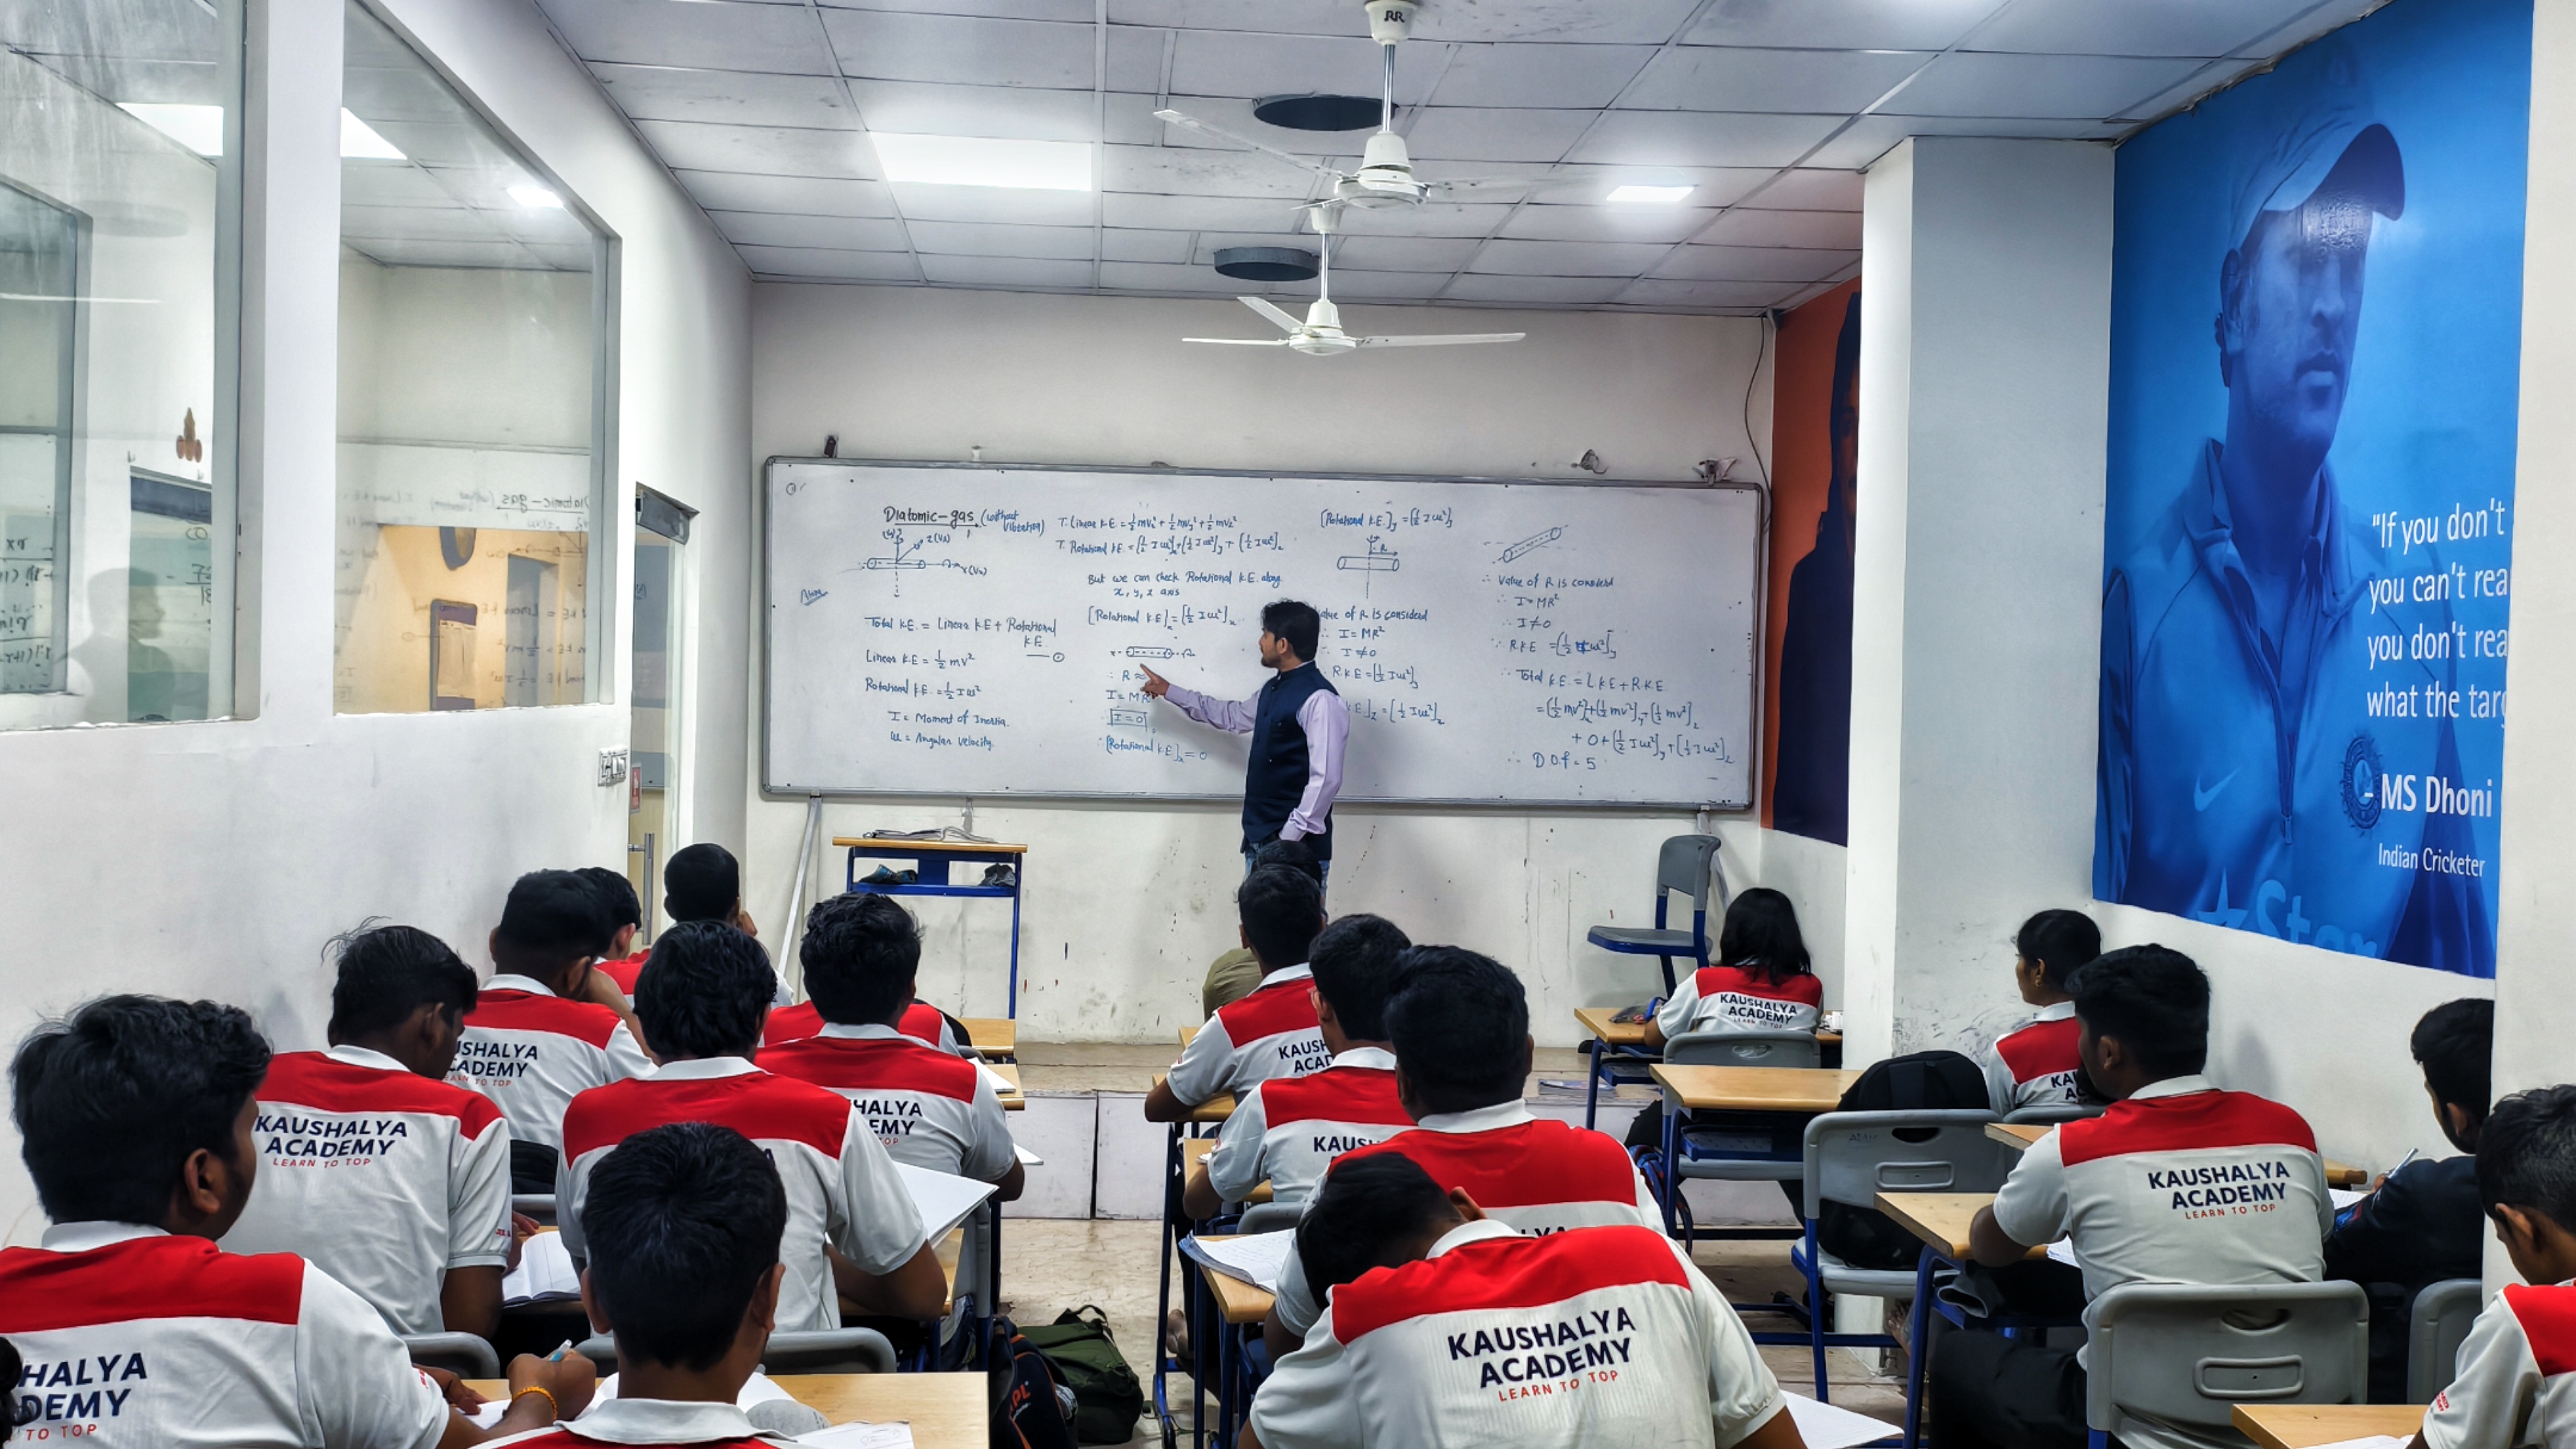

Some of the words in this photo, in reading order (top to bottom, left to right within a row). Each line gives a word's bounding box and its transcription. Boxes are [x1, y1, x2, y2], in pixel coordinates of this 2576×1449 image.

[2401, 516, 2438, 555] you
[2446, 497, 2505, 541] don't
[2369, 577, 2404, 614] you
[2412, 562, 2466, 602] can't
[1318, 608, 1339, 619] alue
[2368, 635, 2402, 670] you
[2411, 621, 2466, 660] don't
[2367, 681, 2418, 718] what
[2425, 680, 2460, 718] the
[2381, 773, 2417, 813] MS
[2426, 776, 2492, 818] Dhoni
[2379, 843, 2418, 870] Indian
[2423, 848, 2485, 878] Cricketer
[1720, 994, 1797, 1014] KAUSHALYA
[1728, 1006, 1793, 1024] ACADEMY
[255, 1115, 408, 1138] KAUSHALYA
[265, 1137, 396, 1158] ACADEMY
[272, 1158, 316, 1168] LEARN
[324, 1159, 338, 1169] TO
[346, 1158, 371, 1167] TOP
[2148, 1162, 2290, 1189] KAUSHALYA
[2172, 1182, 2285, 1209] ACADEMY
[2185, 1209, 2226, 1220] LEARN
[2231, 1206, 2248, 1216] TO
[2253, 1204, 2276, 1214] TOP
[1447, 1306, 1637, 1361] KAUSHALYA
[1480, 1338, 1631, 1389] ACADEMY
[1498, 1384, 1553, 1402] LEARN
[1560, 1379, 1580, 1393] TO
[1588, 1370, 1619, 1384] TOP
[26, 1428, 49, 1441] TO
[62, 1423, 97, 1438] TOP
